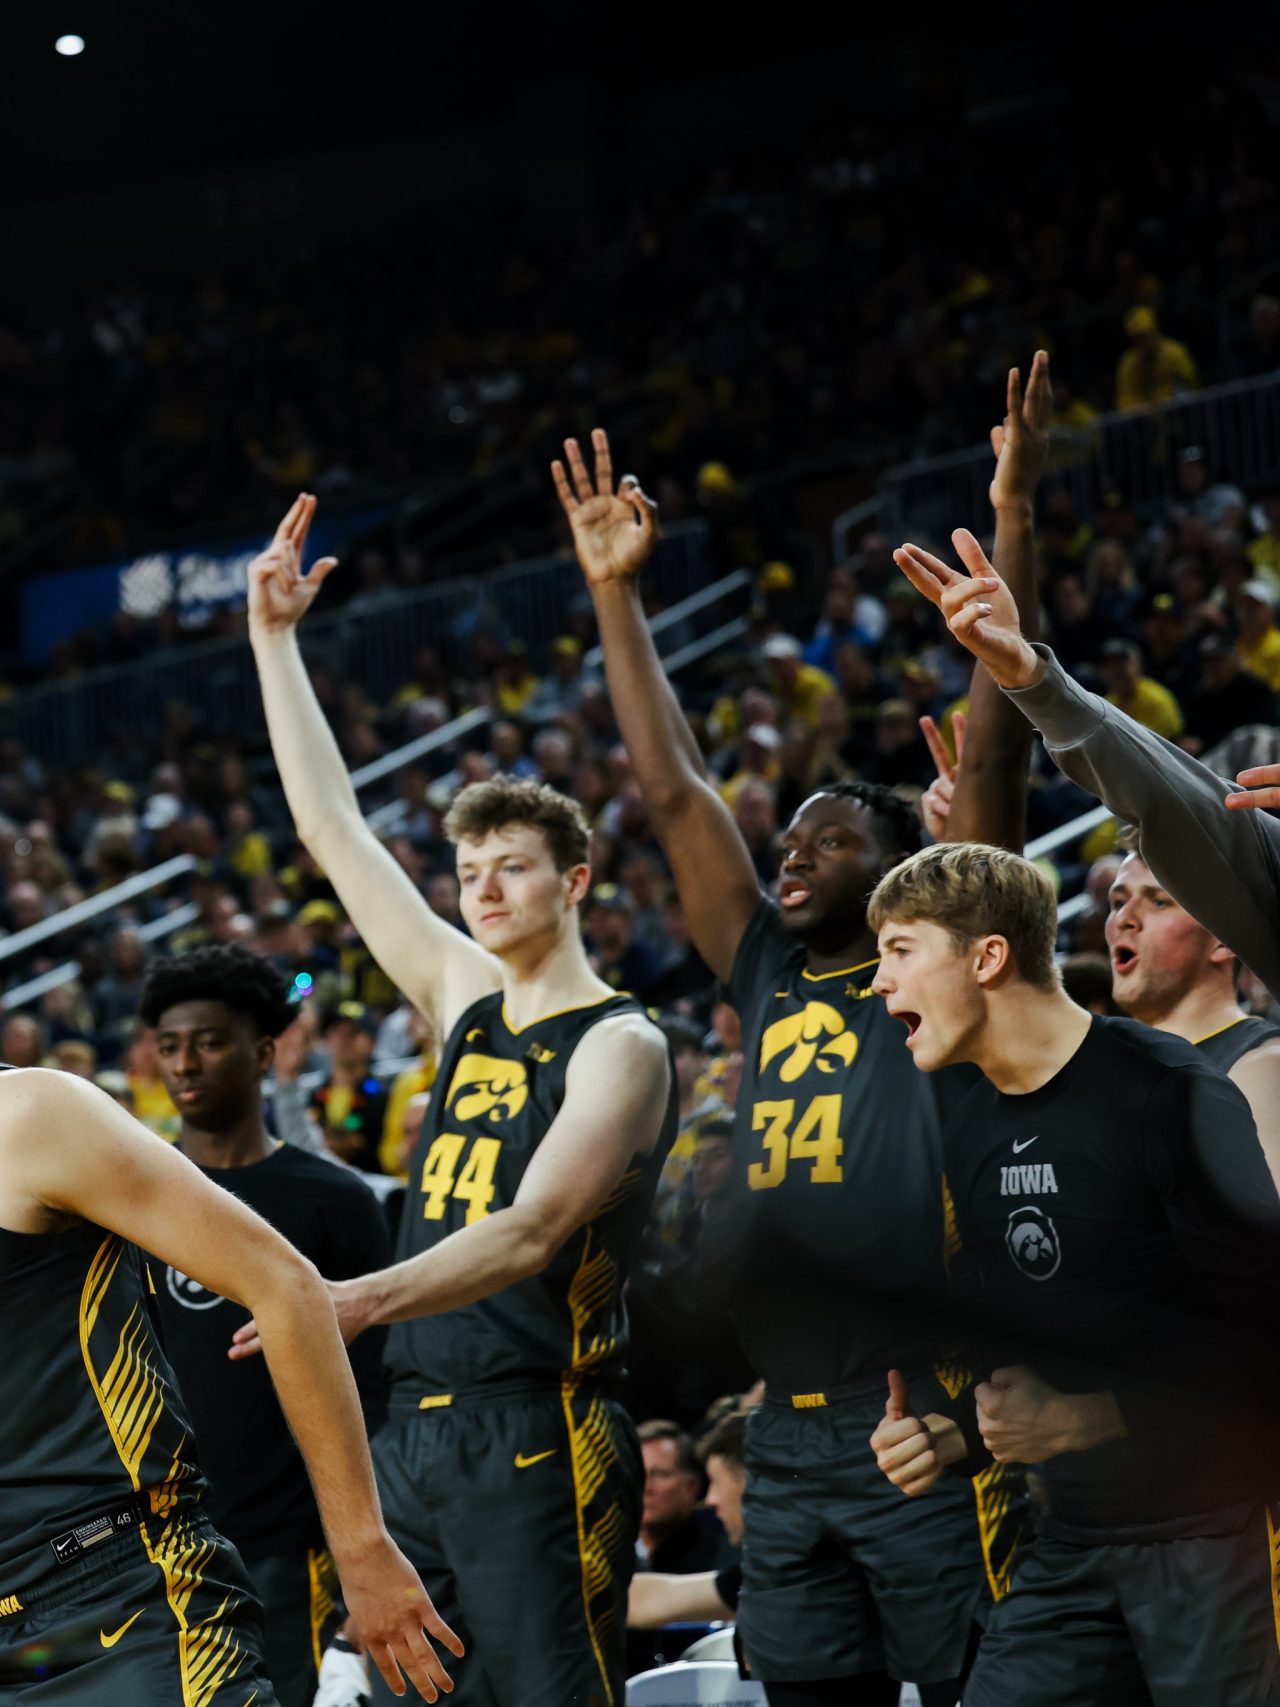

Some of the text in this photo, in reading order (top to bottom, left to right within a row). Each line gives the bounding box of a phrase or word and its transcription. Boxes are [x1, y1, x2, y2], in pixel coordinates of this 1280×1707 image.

[747, 1093, 844, 1191] 34
[420, 1133, 501, 1224] 44
[1000, 1163, 1058, 1196] IOWA
[75, 1516, 107, 1535] ENGINEERED
[117, 1512, 131, 1526] 46
[59, 1545, 79, 1558] TEAM
